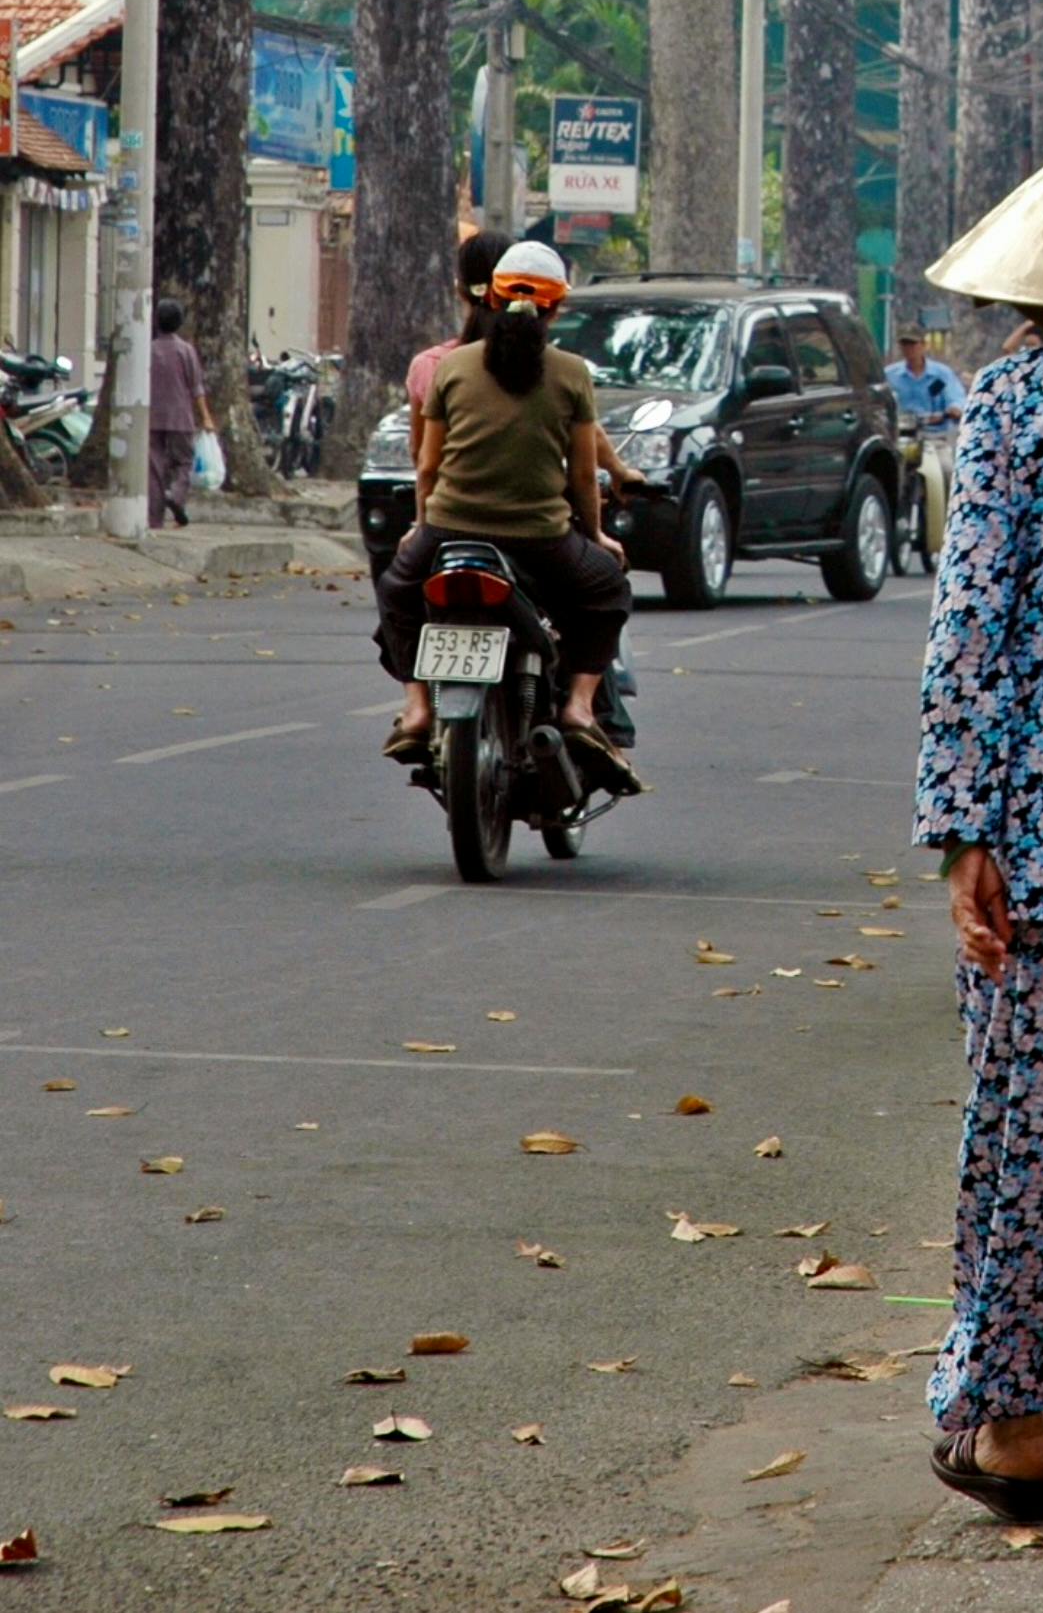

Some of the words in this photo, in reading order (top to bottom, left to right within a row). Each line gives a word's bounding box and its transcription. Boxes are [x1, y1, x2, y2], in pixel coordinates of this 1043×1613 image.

[557, 120, 633, 143] REVTEX
[603, 174, 621, 190] XE
[431, 654, 489, 676] 7767
